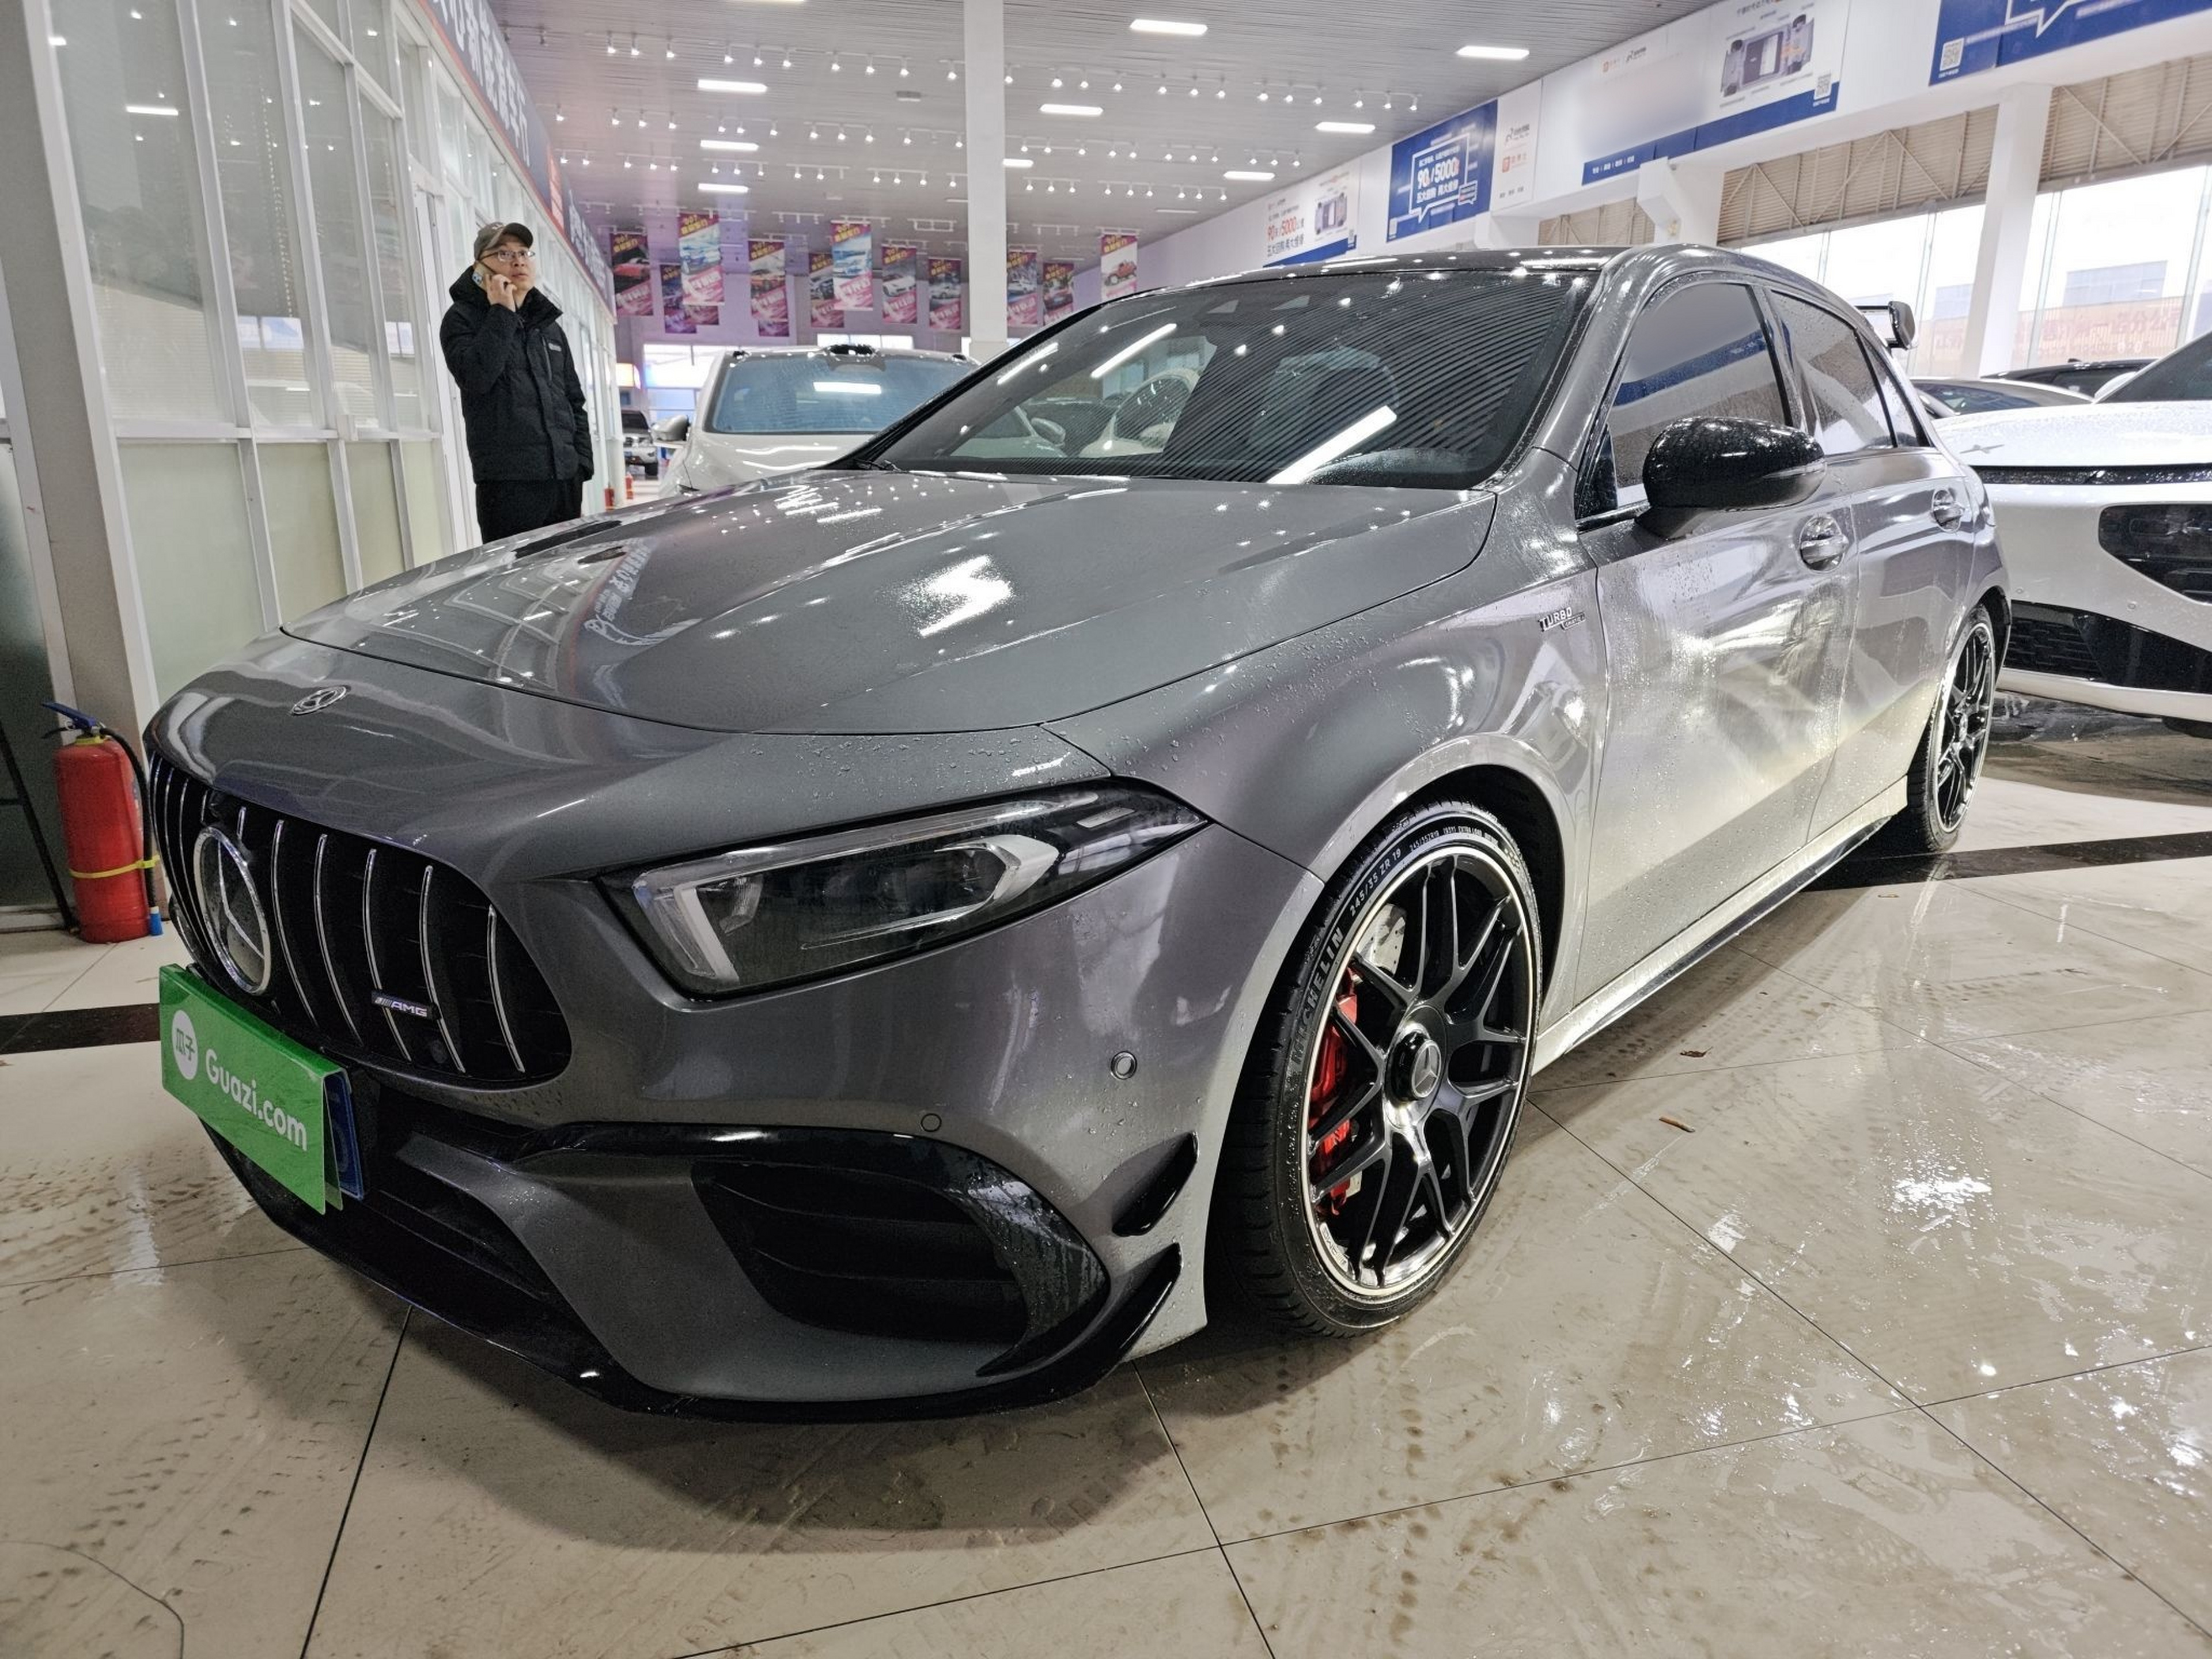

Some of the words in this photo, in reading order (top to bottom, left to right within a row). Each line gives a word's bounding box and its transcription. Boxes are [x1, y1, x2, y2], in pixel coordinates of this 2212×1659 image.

[1539, 607, 1572, 631] TURBO
[1350, 872, 1378, 917] 245/35
[1392, 848, 1402, 861] 19
[391, 1001, 427, 1017] AMG
[206, 1048, 308, 1152] Guazi.com
